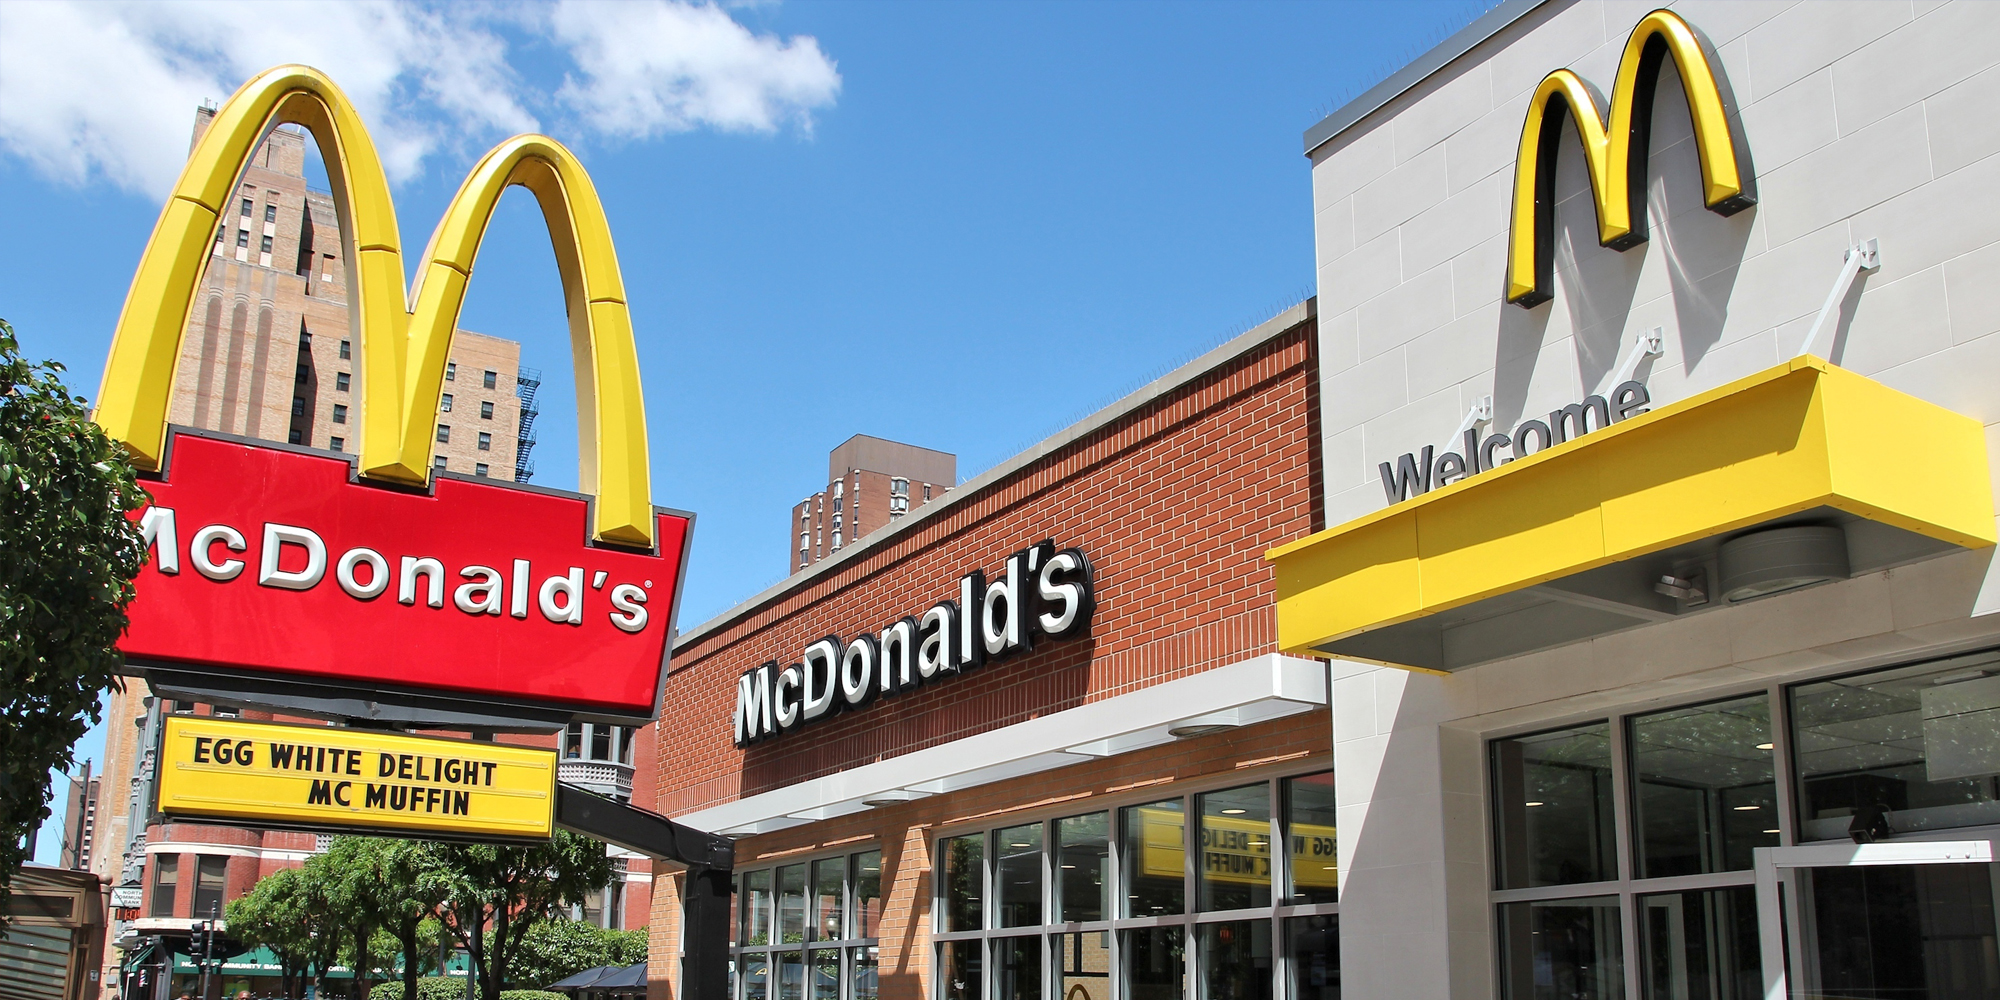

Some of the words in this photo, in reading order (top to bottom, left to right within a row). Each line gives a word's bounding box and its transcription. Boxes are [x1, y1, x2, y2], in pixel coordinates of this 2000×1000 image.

[1378, 380, 1651, 506] Welcome
[734, 540, 1092, 747] McDonald's
[193, 737, 254, 766] EGG
[270, 742, 362, 776] WHITE
[378, 753, 497, 786] DELIGHT
[307, 780, 351, 806] MC
[365, 784, 470, 816] MUFFIN
